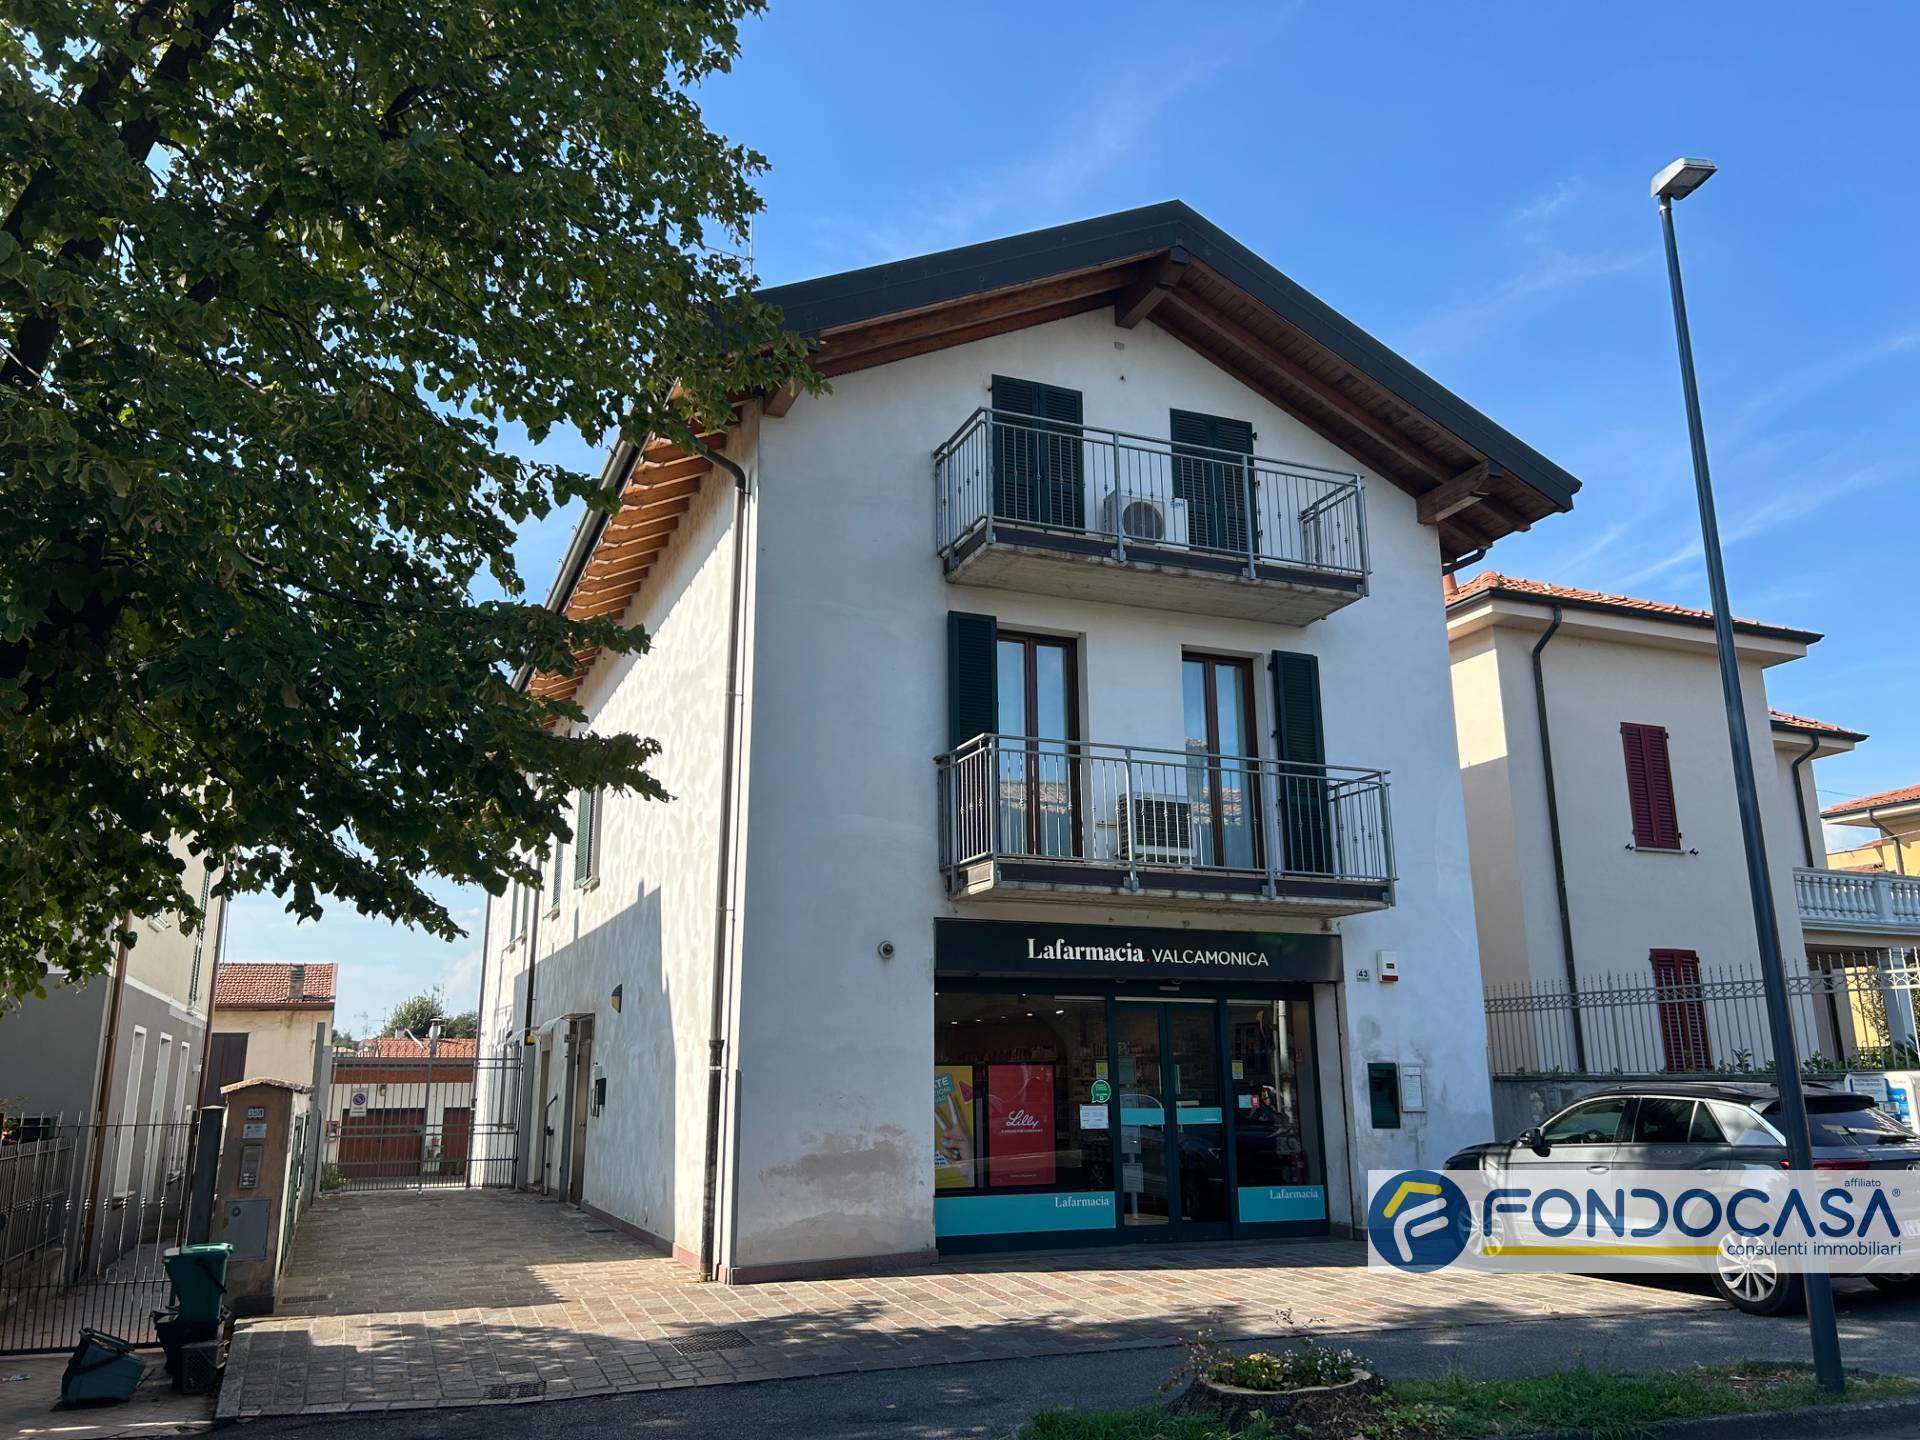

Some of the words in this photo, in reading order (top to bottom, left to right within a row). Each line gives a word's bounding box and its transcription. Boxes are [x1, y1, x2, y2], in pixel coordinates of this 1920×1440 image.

[1151, 948, 1269, 966] VALCAMONICA
[1005, 1108, 1040, 1129] Lilly
[1054, 1195, 1110, 1208] Lafarmacia
[1269, 1188, 1319, 1200] Lafarmacia
